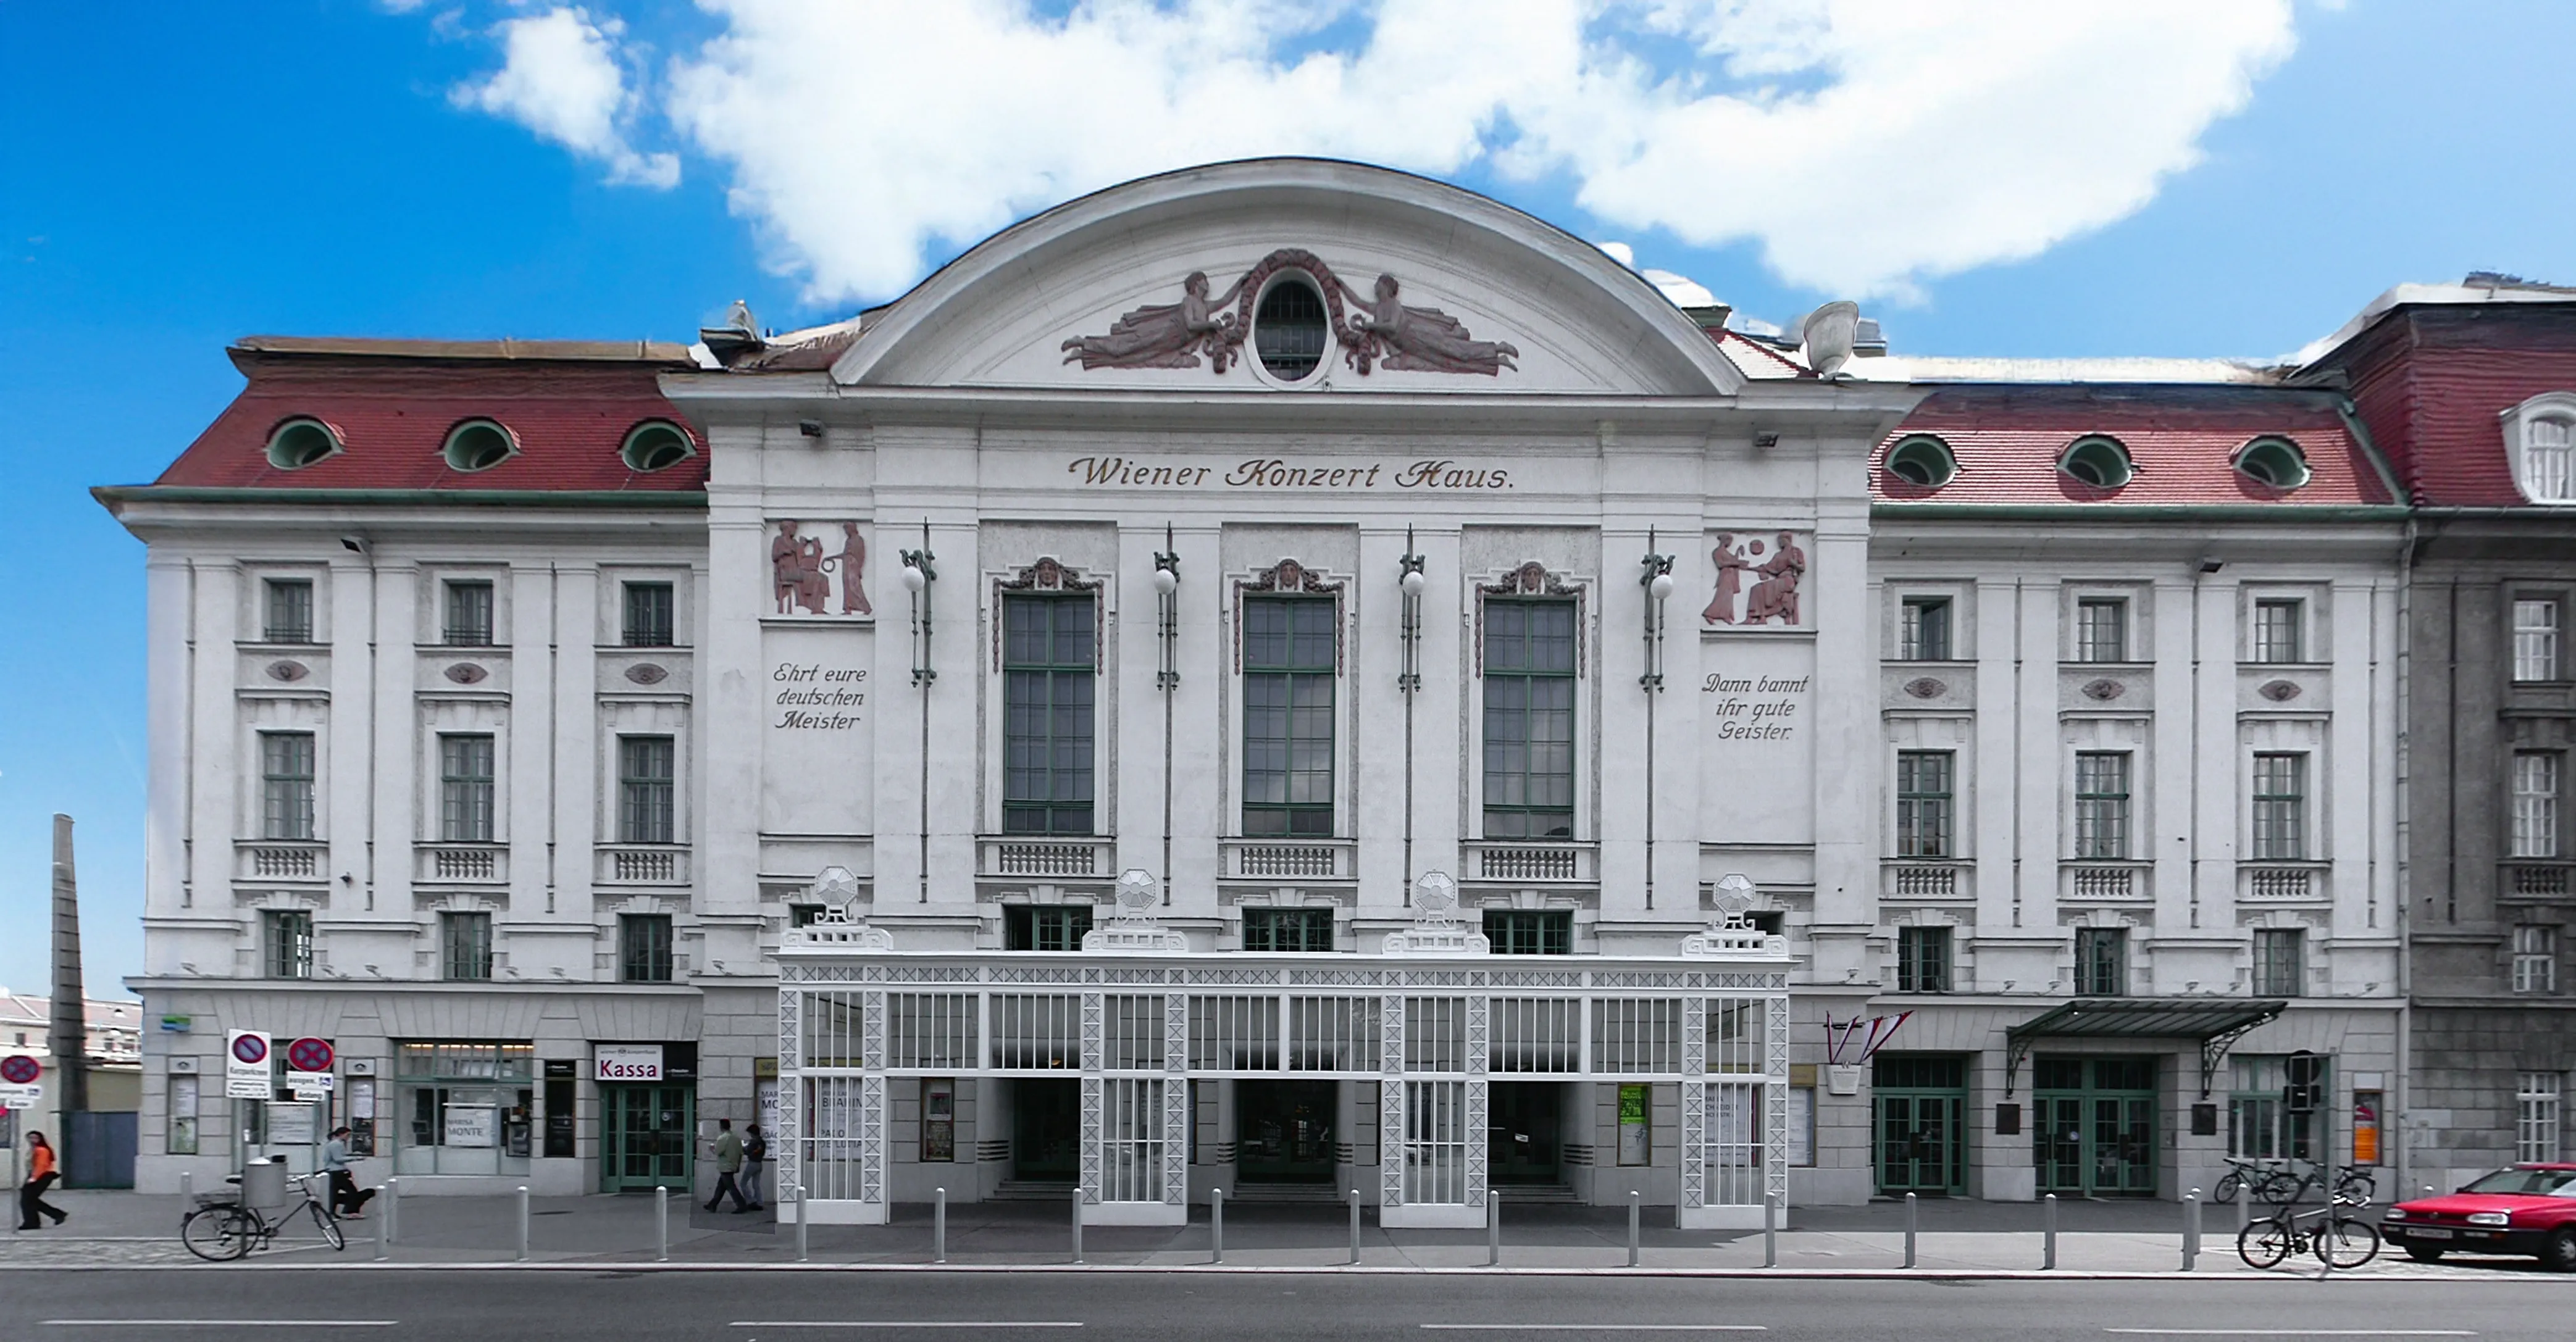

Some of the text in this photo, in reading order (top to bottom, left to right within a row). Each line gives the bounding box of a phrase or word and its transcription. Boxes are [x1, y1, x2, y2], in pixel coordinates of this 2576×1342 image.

[1068, 457, 1514, 489] Wiener Konzert Haus.
[773, 662, 867, 682] Ehrt eure
[1701, 673, 1810, 693] Dann bannt
[777, 687, 864, 706] deutschen
[1716, 698, 1795, 722] ihr gute
[775, 711, 860, 730] Meister
[1718, 720, 1793, 740] Geister.
[600, 1059, 657, 1077] Kassa
[448, 1127, 484, 1136] MONTE
